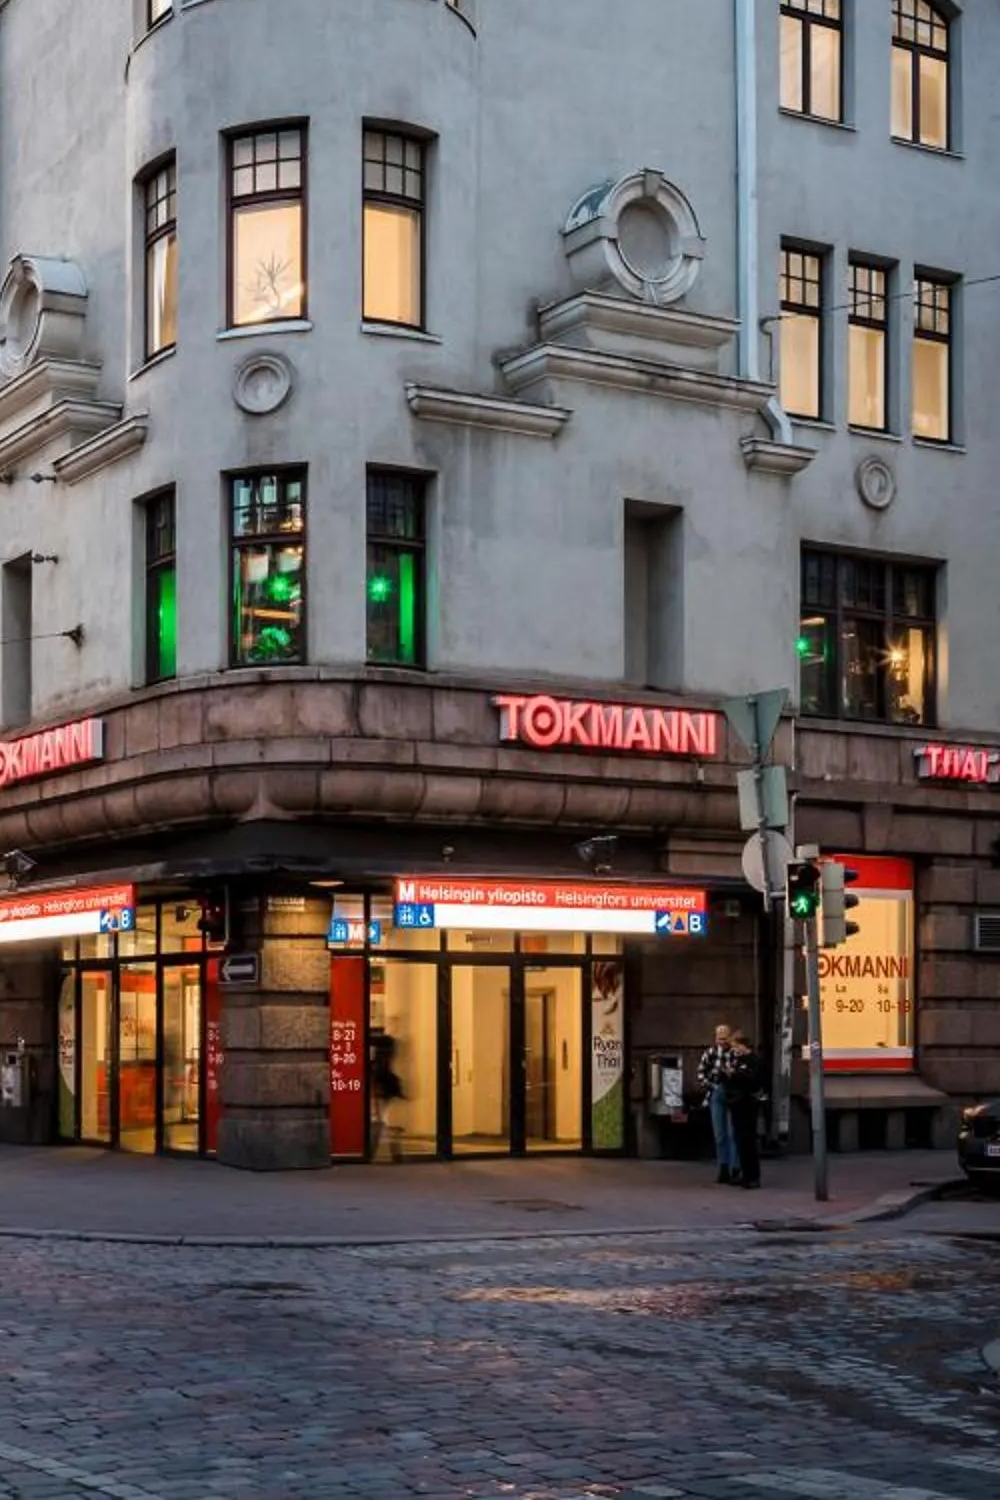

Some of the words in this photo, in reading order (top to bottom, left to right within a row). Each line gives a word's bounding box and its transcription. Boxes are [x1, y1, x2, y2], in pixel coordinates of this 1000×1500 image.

[495, 696, 717, 755] TOKMANNI
[922, 744, 988, 780] THAI
[399, 881, 415, 901] M
[419, 885, 484, 902] Helsingin
[487, 888, 546, 904] yliopisto
[555, 891, 628, 908] Helsingfors
[631, 896, 697, 909] universitet
[689, 914, 701, 932] B
[818, 953, 908, 979] OKMANNI
[835, 1000, 865, 1013] 9-20
